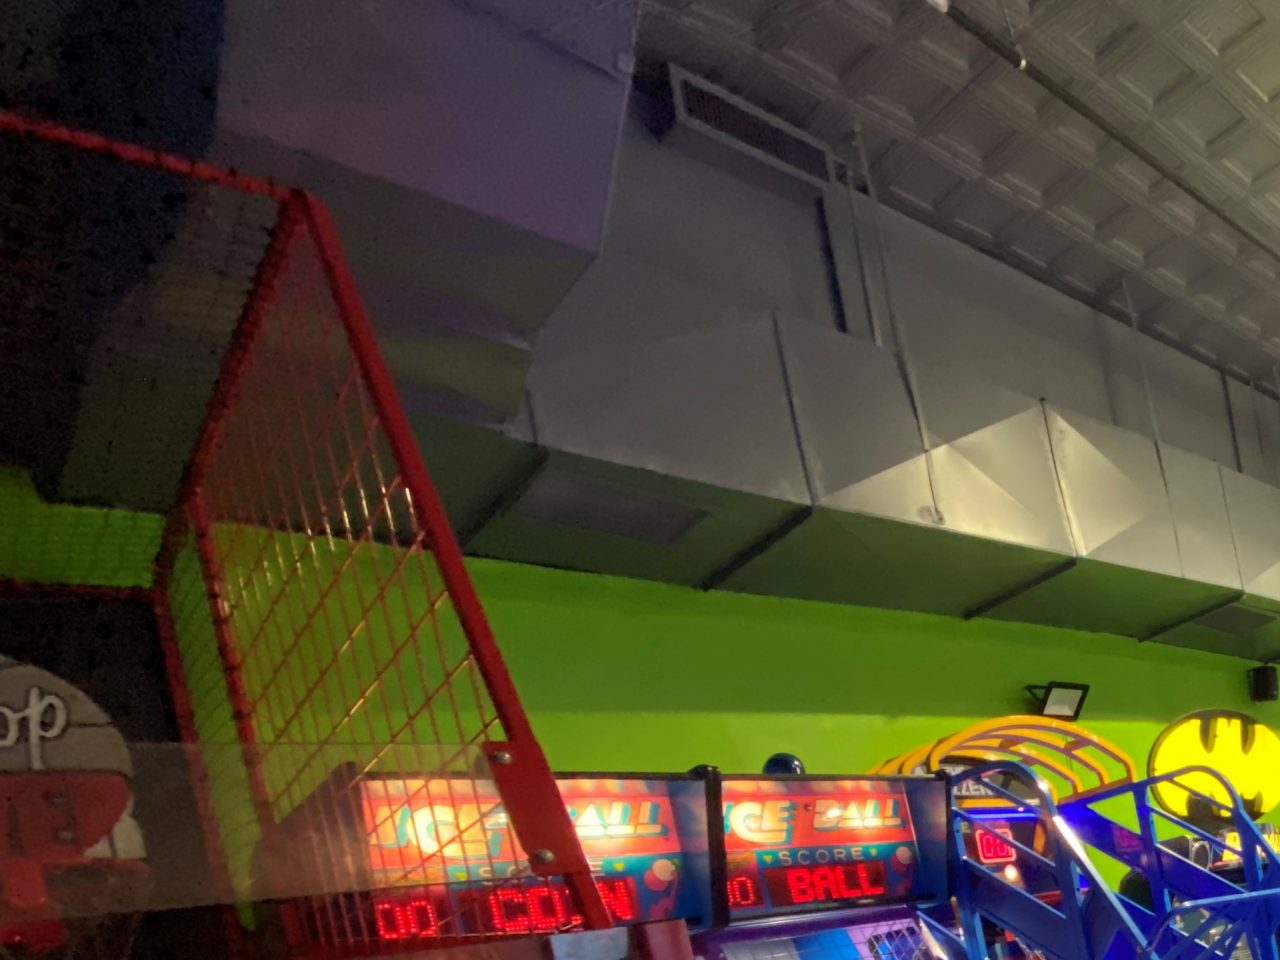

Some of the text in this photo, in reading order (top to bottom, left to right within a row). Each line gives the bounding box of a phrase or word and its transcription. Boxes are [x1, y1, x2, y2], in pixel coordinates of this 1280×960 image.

[729, 798, 904, 845] CE BALL
[779, 847, 864, 867] SCORE
[785, 864, 885, 904] BALL
[489, 881, 634, 933] CON
